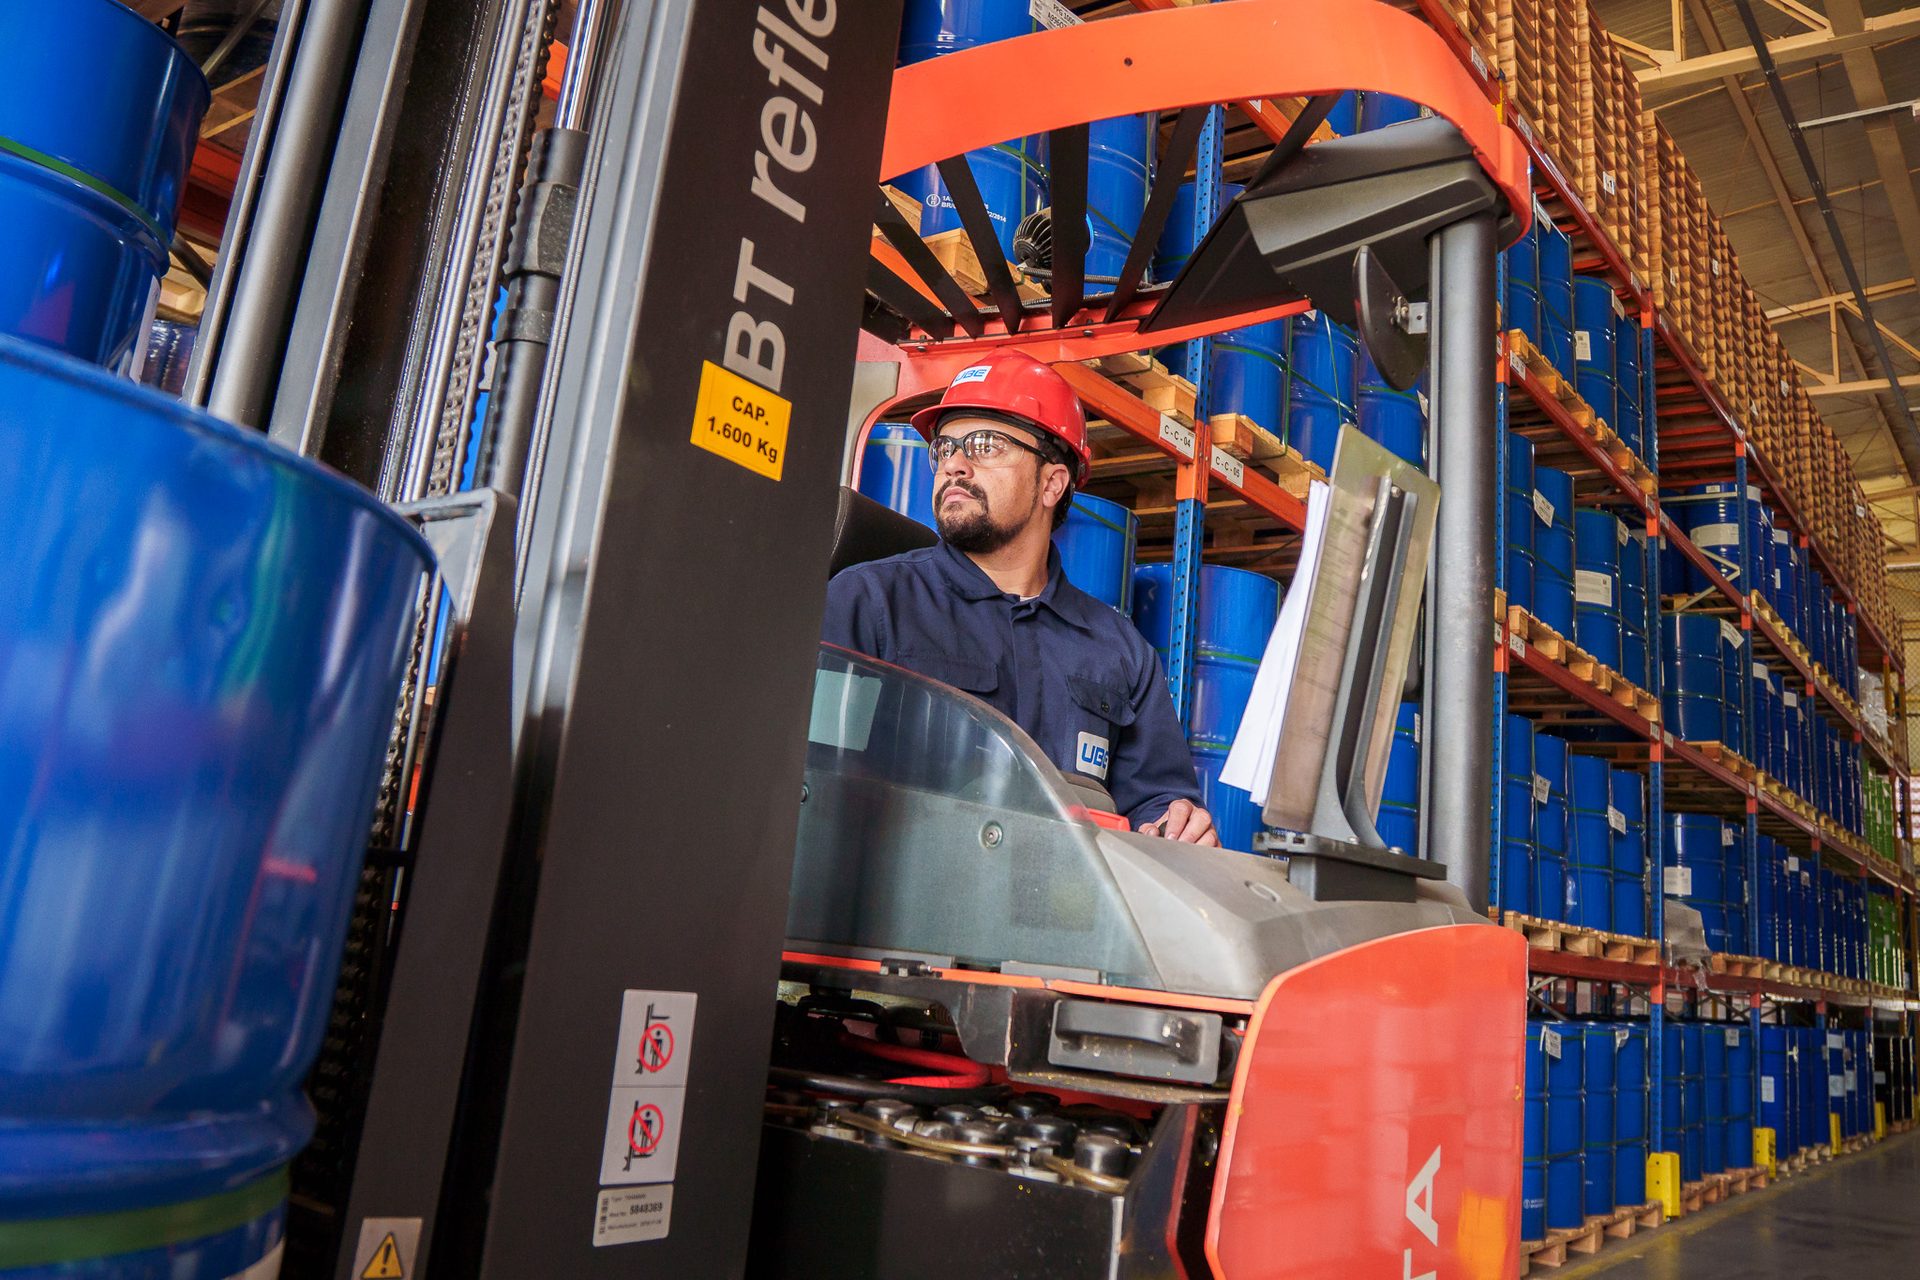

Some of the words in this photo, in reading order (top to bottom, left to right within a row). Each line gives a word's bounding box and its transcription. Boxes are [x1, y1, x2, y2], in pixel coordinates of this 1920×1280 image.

[723, 237, 795, 393] BT
[731, 395, 769, 426] CAP.
[707, 415, 752, 448] 1.600
[757, 438, 778, 464] Kg
